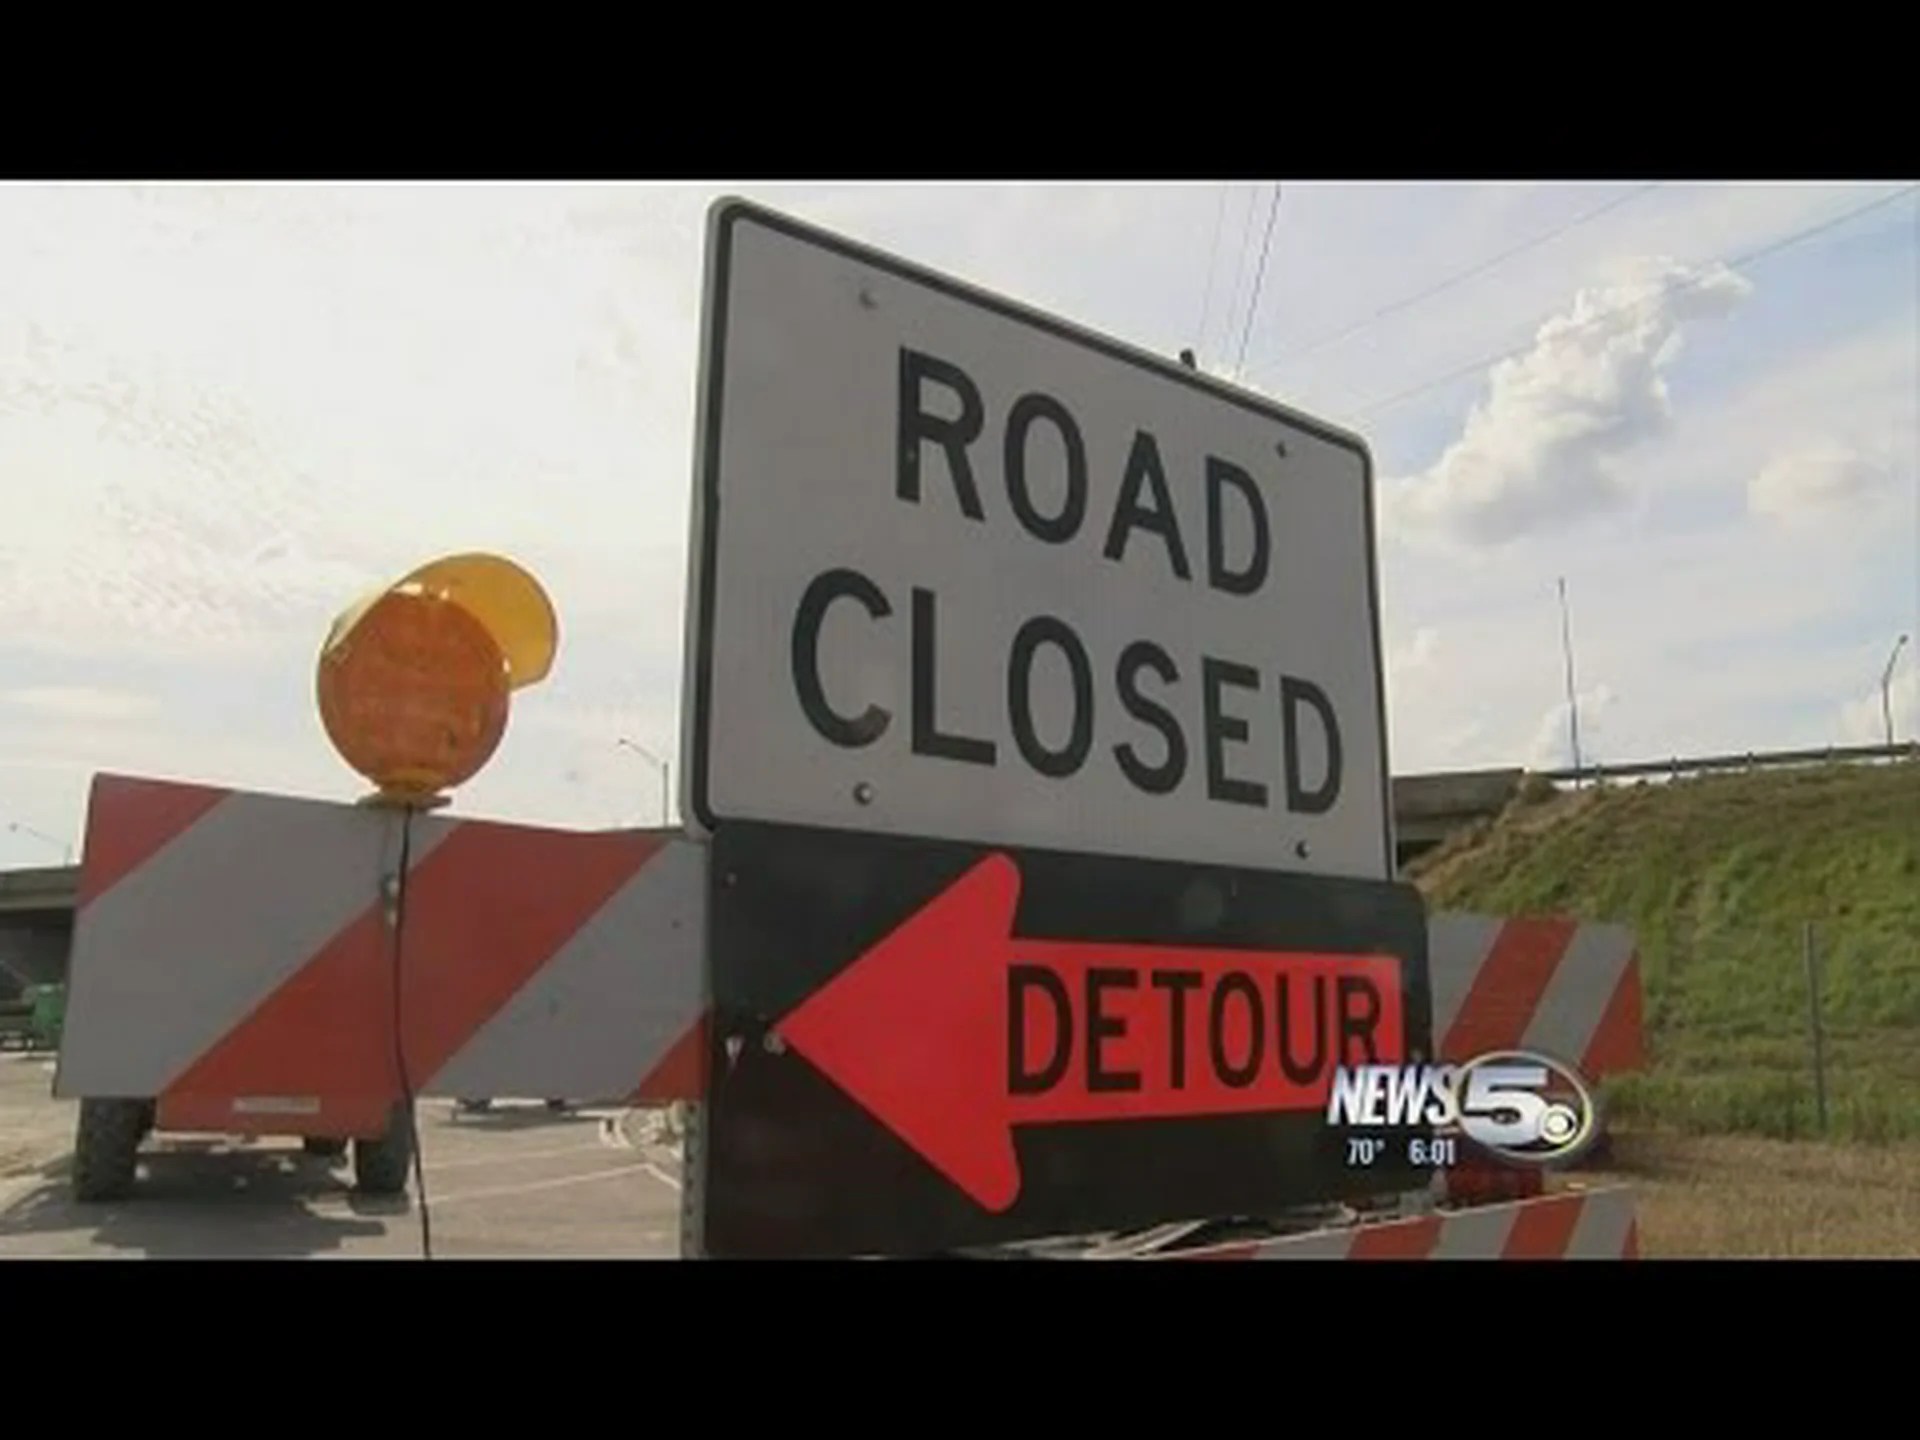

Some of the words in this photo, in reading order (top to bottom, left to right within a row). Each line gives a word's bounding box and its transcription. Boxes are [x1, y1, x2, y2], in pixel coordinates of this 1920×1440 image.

[896, 346, 1271, 595] ROAD
[791, 567, 1343, 814] CLOSED
[1008, 965, 1381, 1095] DETOUR
